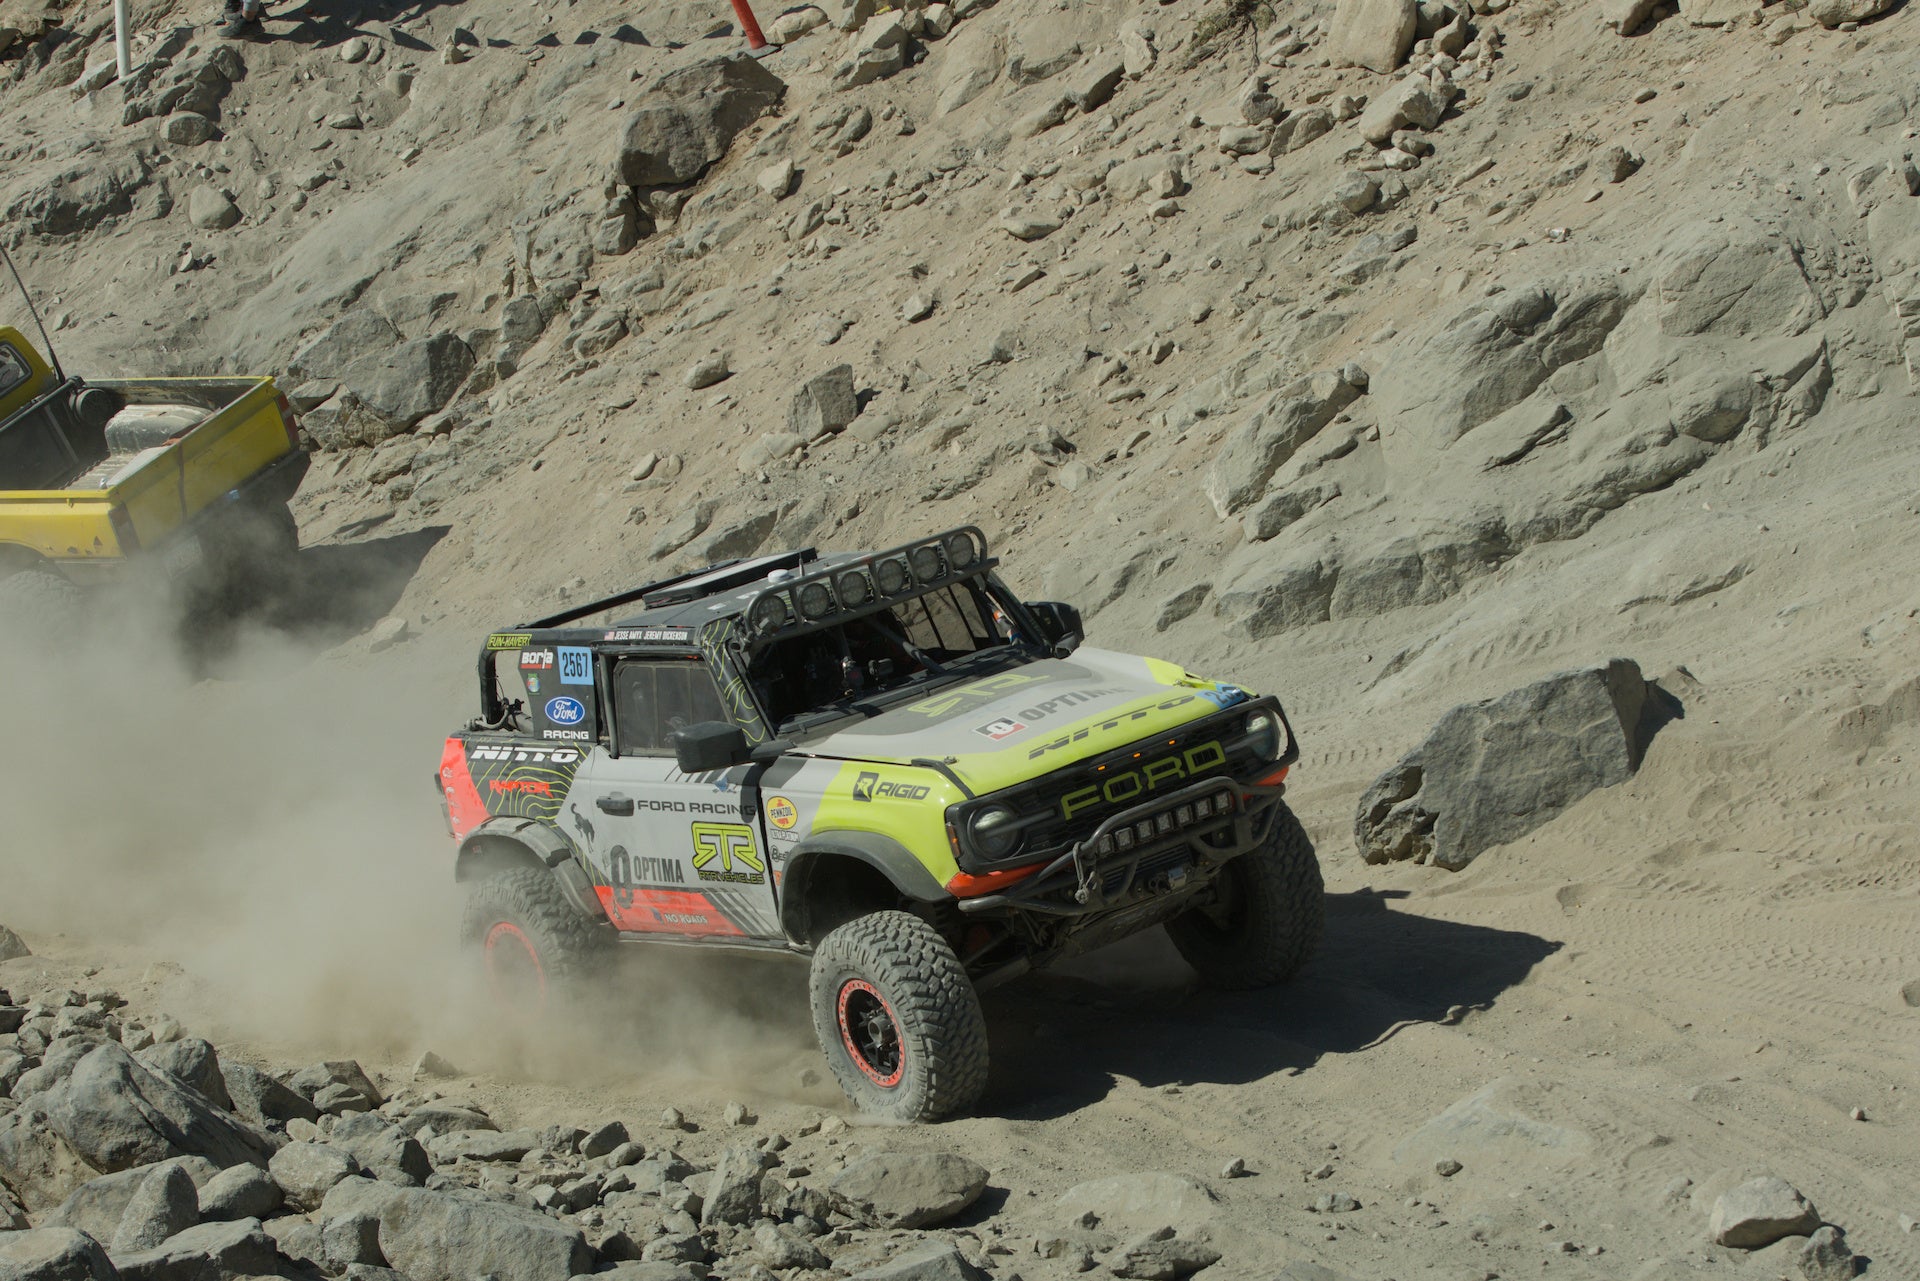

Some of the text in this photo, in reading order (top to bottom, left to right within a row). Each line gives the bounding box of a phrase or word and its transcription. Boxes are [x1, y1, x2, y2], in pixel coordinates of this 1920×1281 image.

[615, 631, 629, 640] JESSE
[644, 631, 662, 640] JEREMY
[562, 651, 588, 678] 2567
[553, 702, 578, 721] Ford
[543, 730, 589, 740] RACING
[1029, 695, 1195, 761] NITTO
[470, 745, 579, 763] NITTO
[489, 780, 555, 799] RAPTOR
[1060, 740, 1227, 821] FORD
[875, 781, 931, 800] RIGID
[637, 800, 756, 817] FORD RACING
[770, 806, 794, 818] PENNZOIL
[633, 855, 685, 884] OPTIMA
[664, 913, 708, 925] NO ROADS
